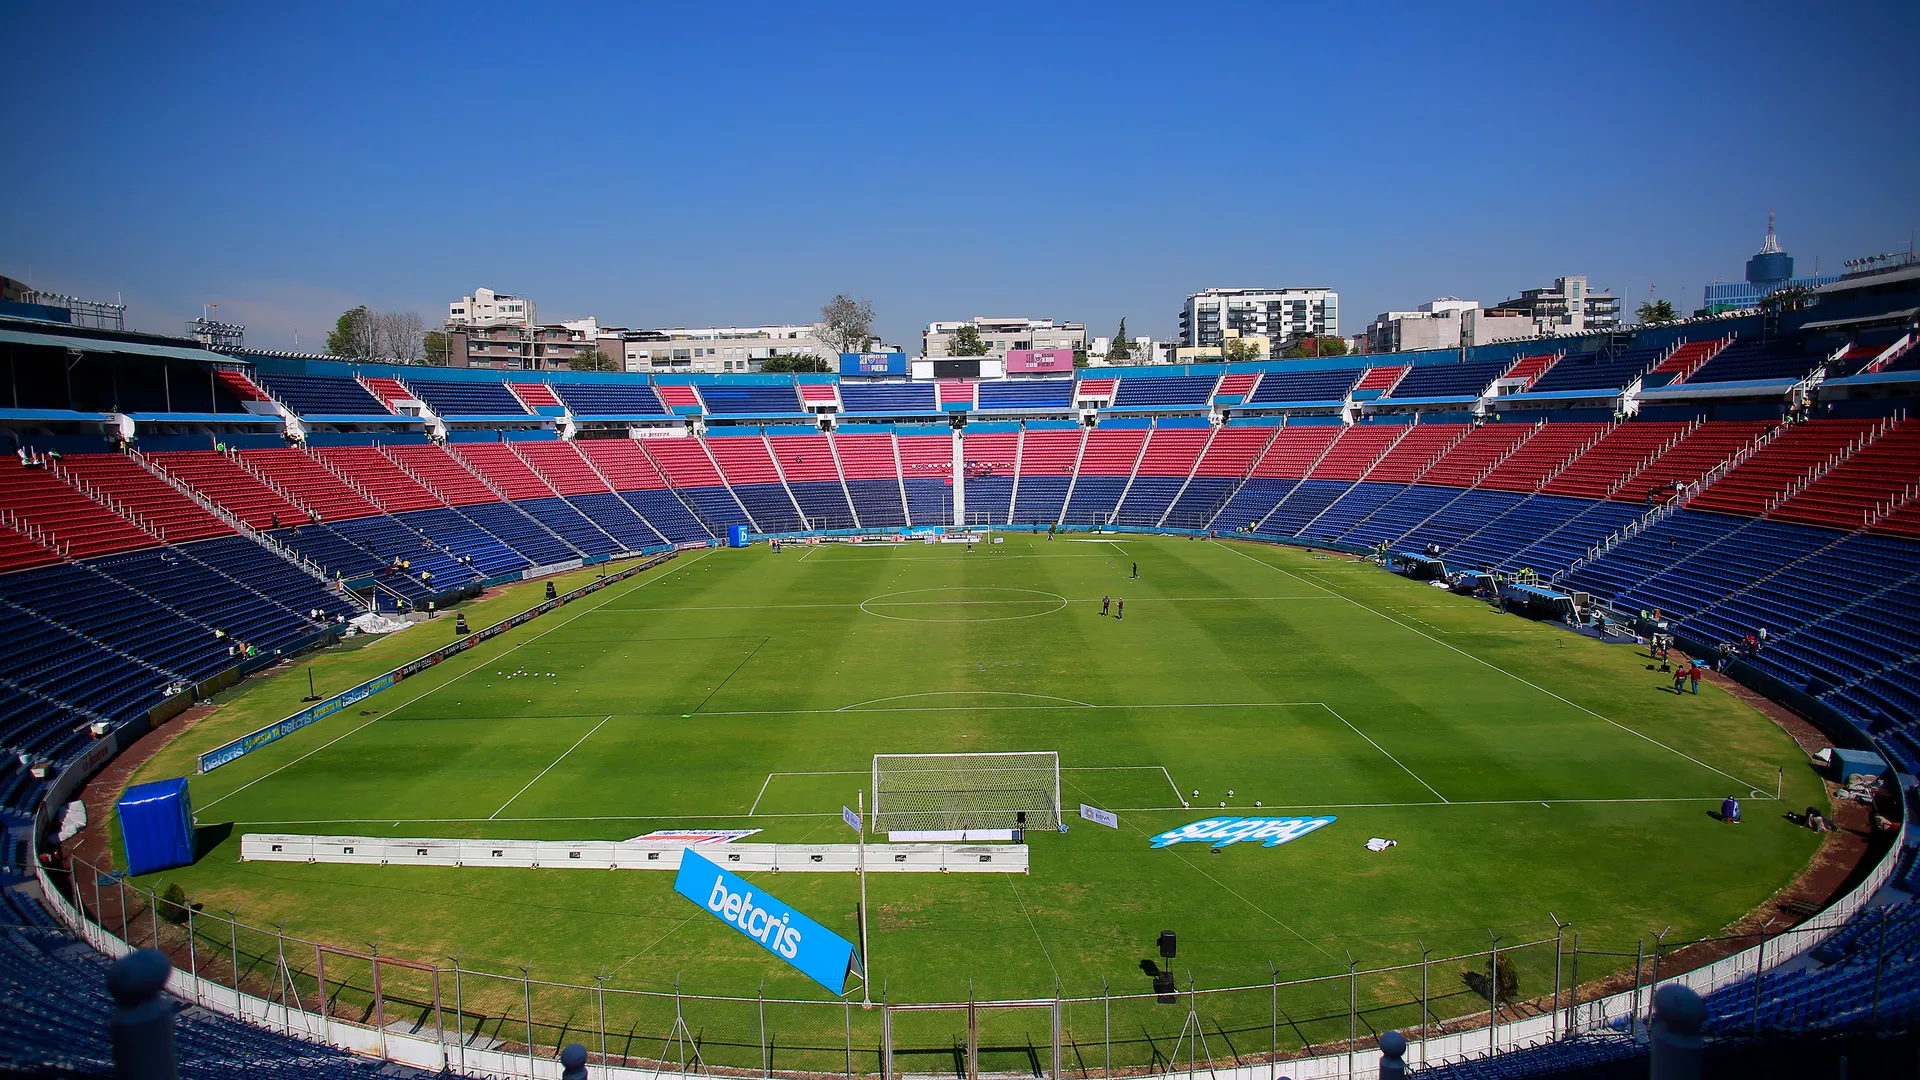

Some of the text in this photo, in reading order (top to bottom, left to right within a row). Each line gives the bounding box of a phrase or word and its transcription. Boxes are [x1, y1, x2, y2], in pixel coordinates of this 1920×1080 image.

[741, 530, 748, 541] b
[203, 745, 244, 772] betcris
[280, 712, 313, 736] betcris
[312, 703, 335, 718] APUESTA
[1160, 819, 1330, 846] betcris
[707, 874, 802, 959] betcris
